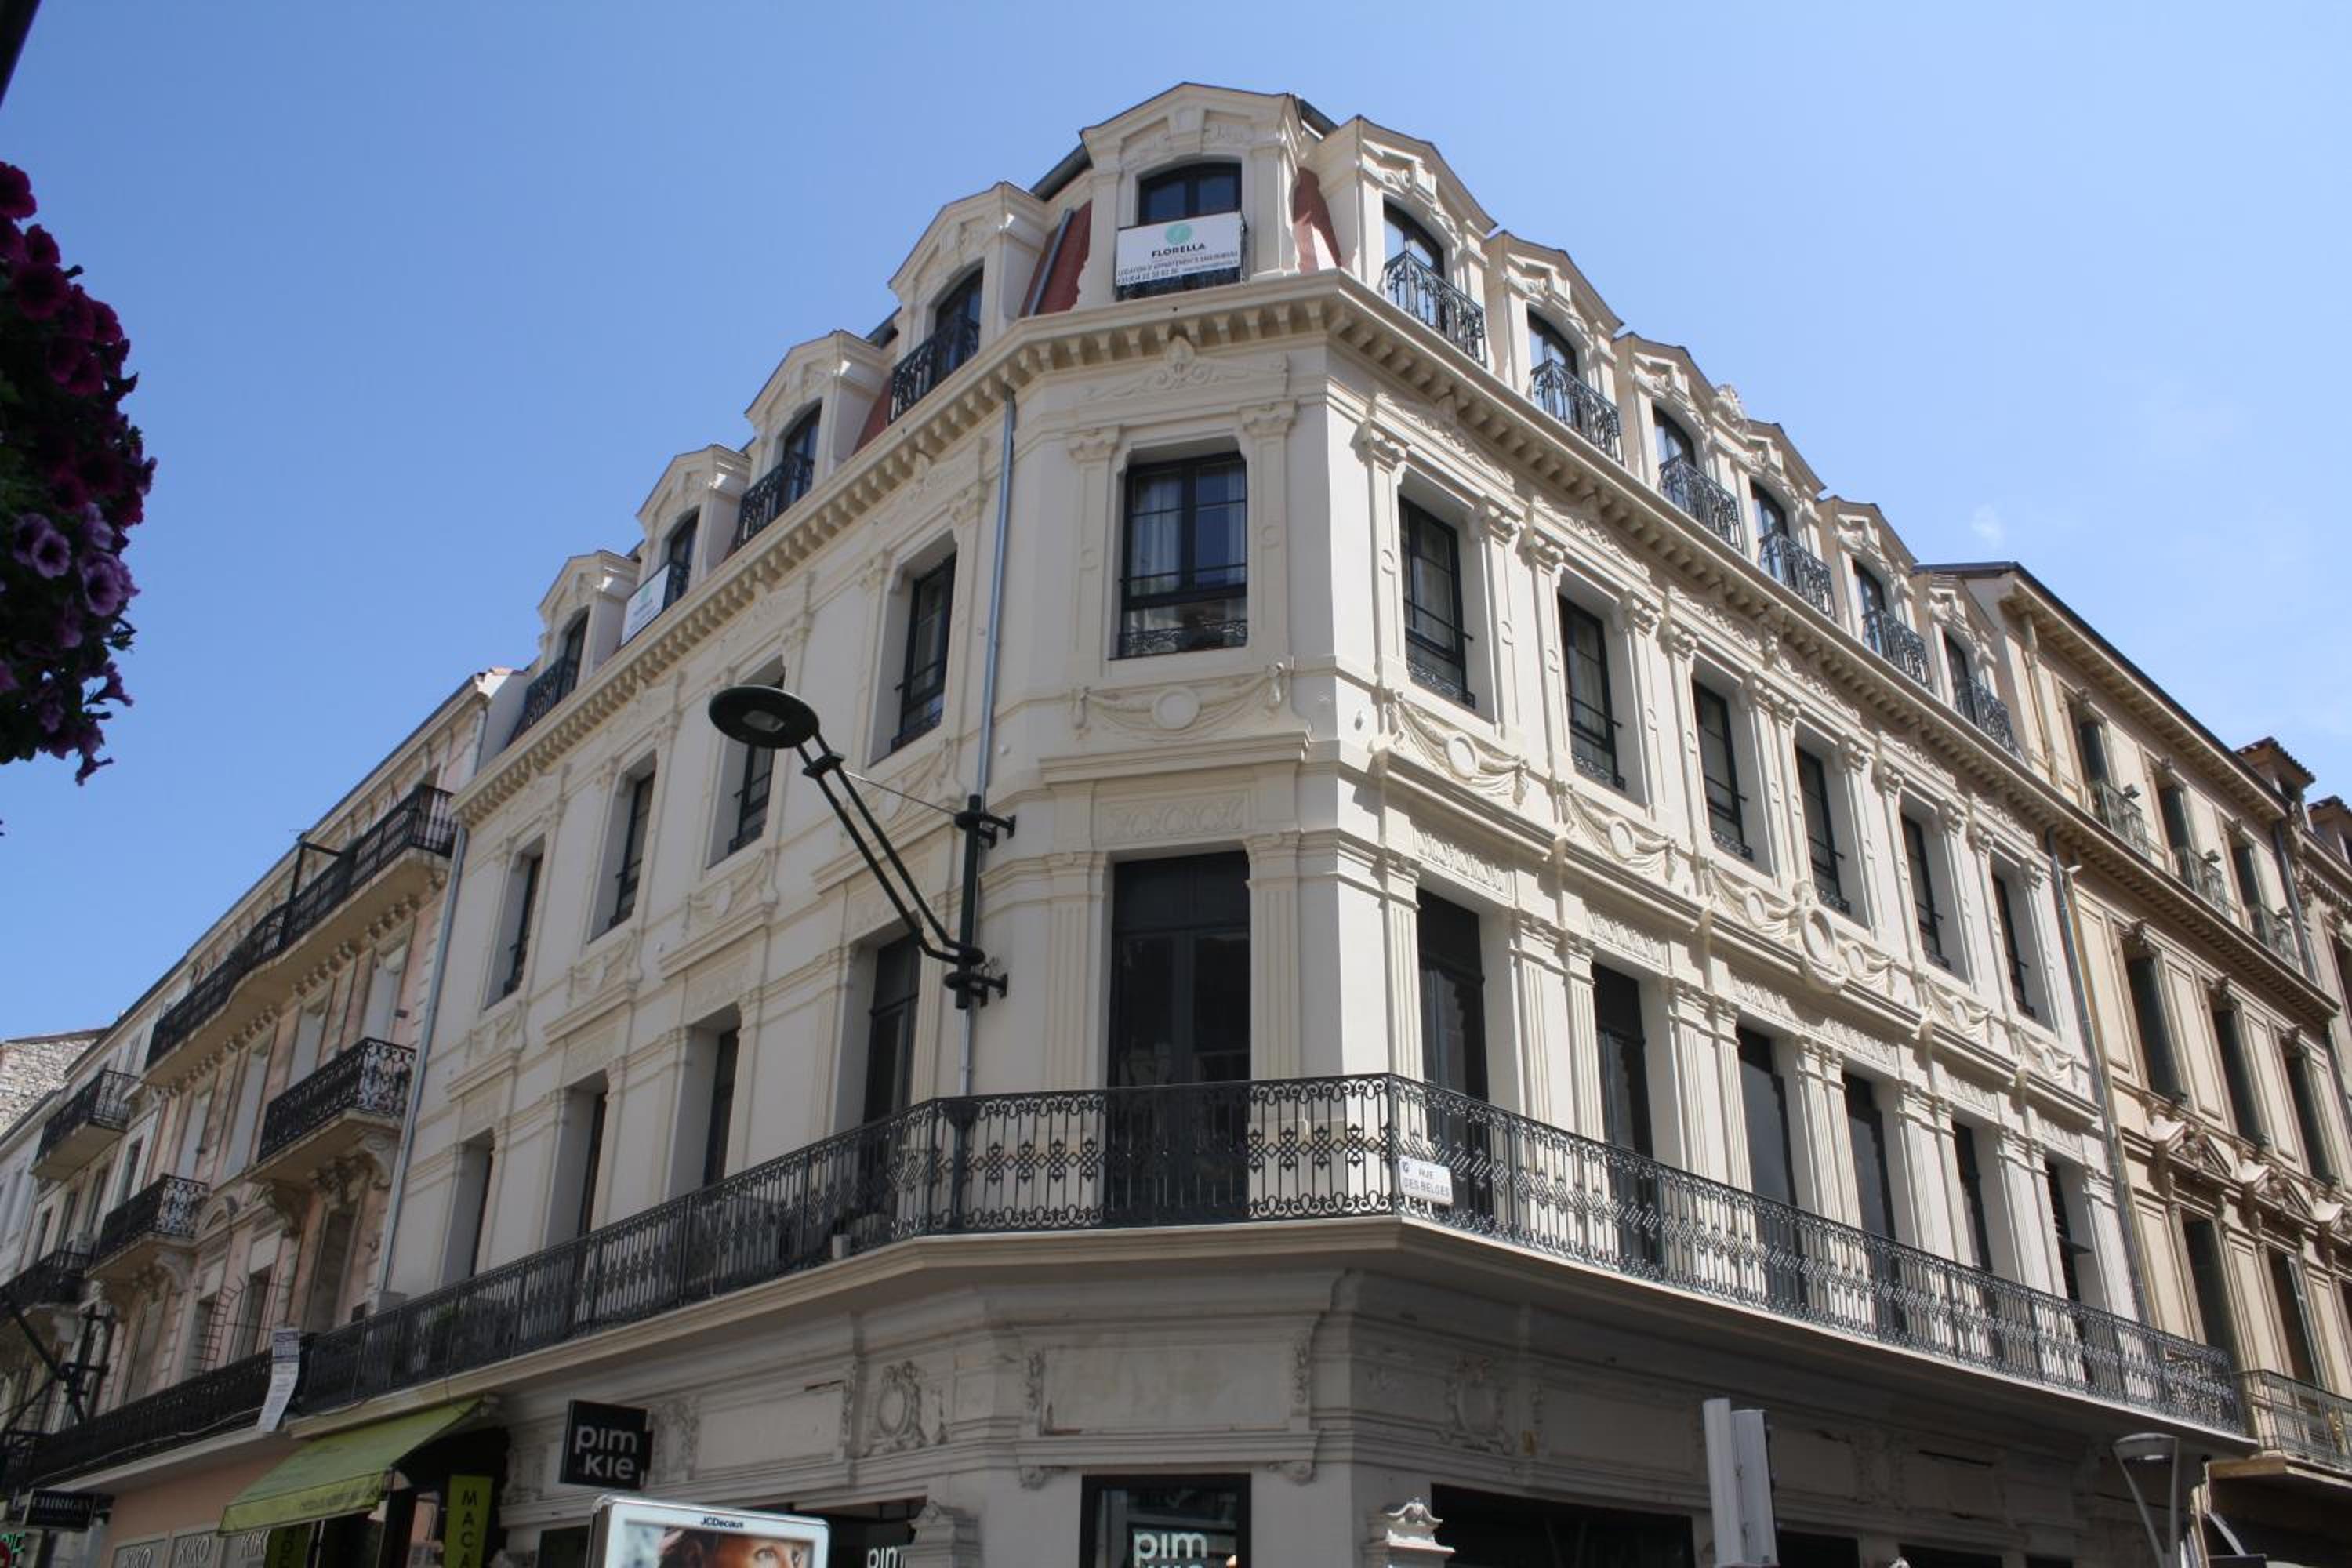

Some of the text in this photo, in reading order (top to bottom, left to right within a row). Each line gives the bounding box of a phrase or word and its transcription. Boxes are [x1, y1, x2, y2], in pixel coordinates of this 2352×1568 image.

[1152, 243, 1205, 257] FLORELLA
[1419, 1168, 1434, 1179] RUE
[1403, 1178, 1450, 1196] DES BELGES
[575, 1425, 637, 1454] pim
[1133, 1533, 1207, 1568] pim
